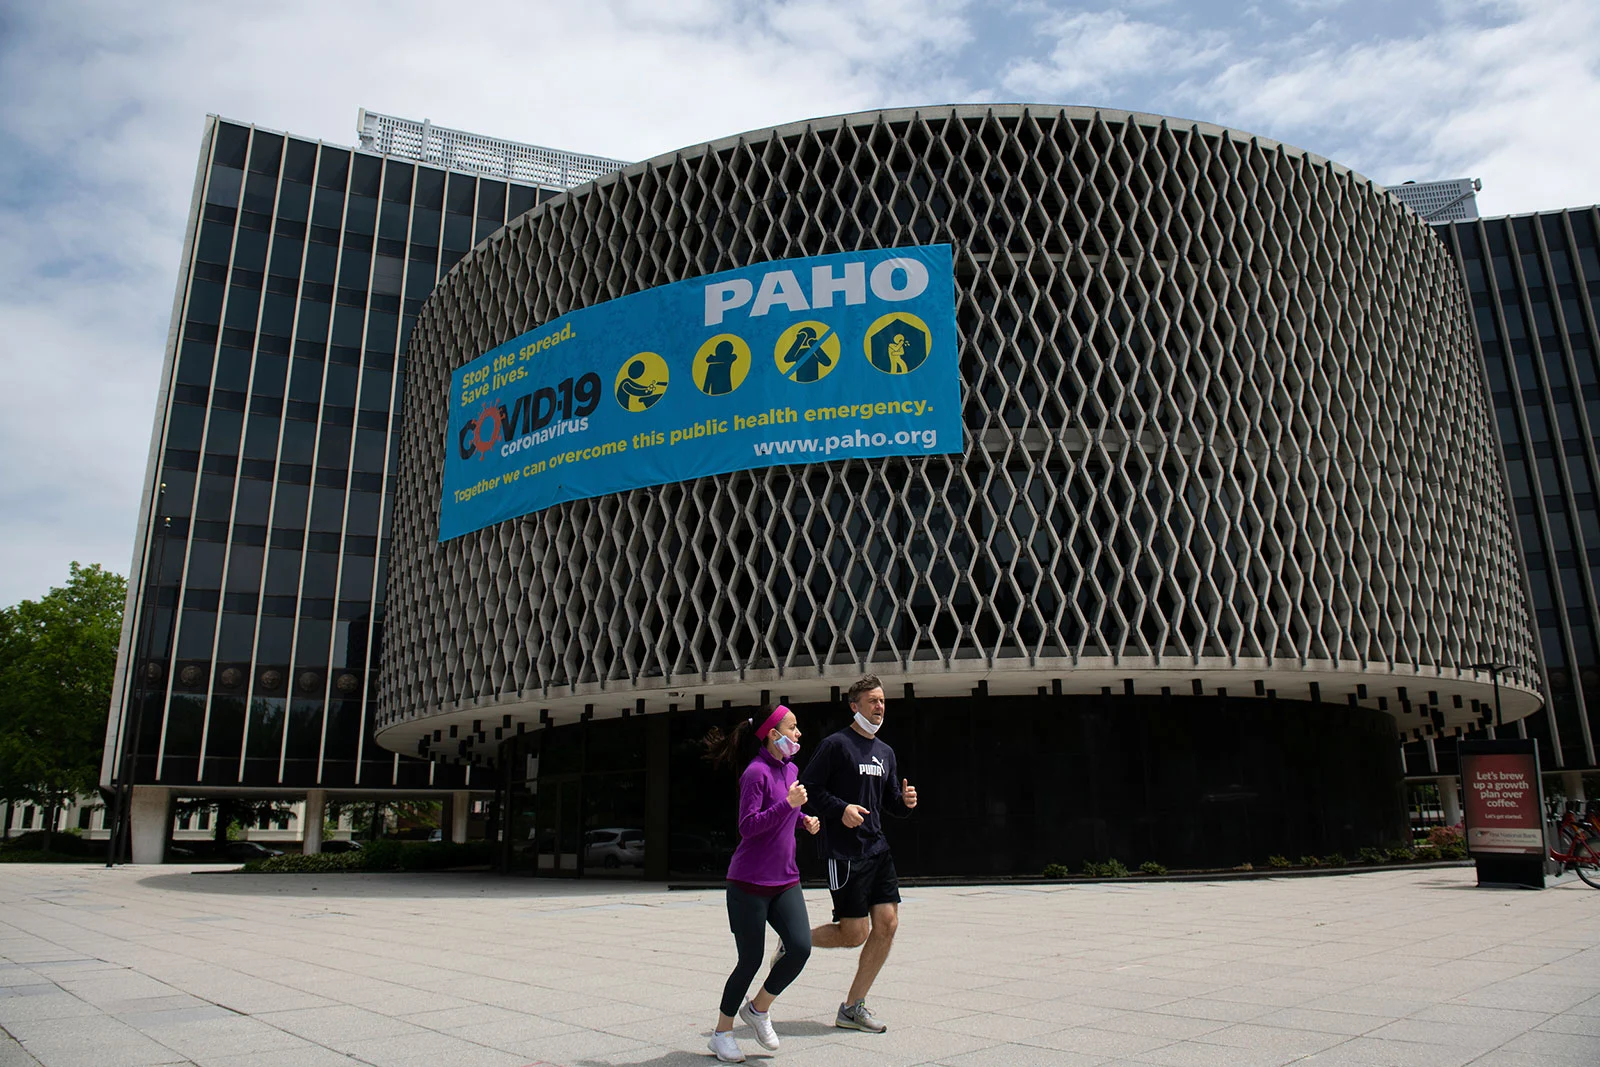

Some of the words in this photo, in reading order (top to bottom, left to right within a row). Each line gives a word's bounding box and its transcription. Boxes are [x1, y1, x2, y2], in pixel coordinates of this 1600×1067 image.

[704, 258, 929, 327] PAHO
[462, 365, 490, 389] Stop
[493, 352, 516, 373] the
[519, 322, 576, 361] spread.
[461, 383, 490, 407] Save
[492, 366, 529, 391] lives.
[459, 371, 602, 461] COVID-19
[454, 476, 501, 503] Together
[502, 469, 520, 485] we
[523, 460, 546, 477] can
[549, 439, 627, 468] overcome
[632, 431, 665, 449] this
[670, 419, 728, 446] public
[733, 407, 798, 431] health
[804, 400, 934, 422] emergency.
[501, 417, 589, 457] coronavirus
[753, 429, 937, 456] www.paho.org
[858, 763, 882, 777] PUMA
[1473, 782, 1486, 790] up
[1495, 780, 1529, 790] growth
[1476, 771, 1498, 780] Let's
[1500, 771, 1524, 780] brew
[1480, 790, 1500, 799] plan
[1487, 799, 1519, 808] coffee.
